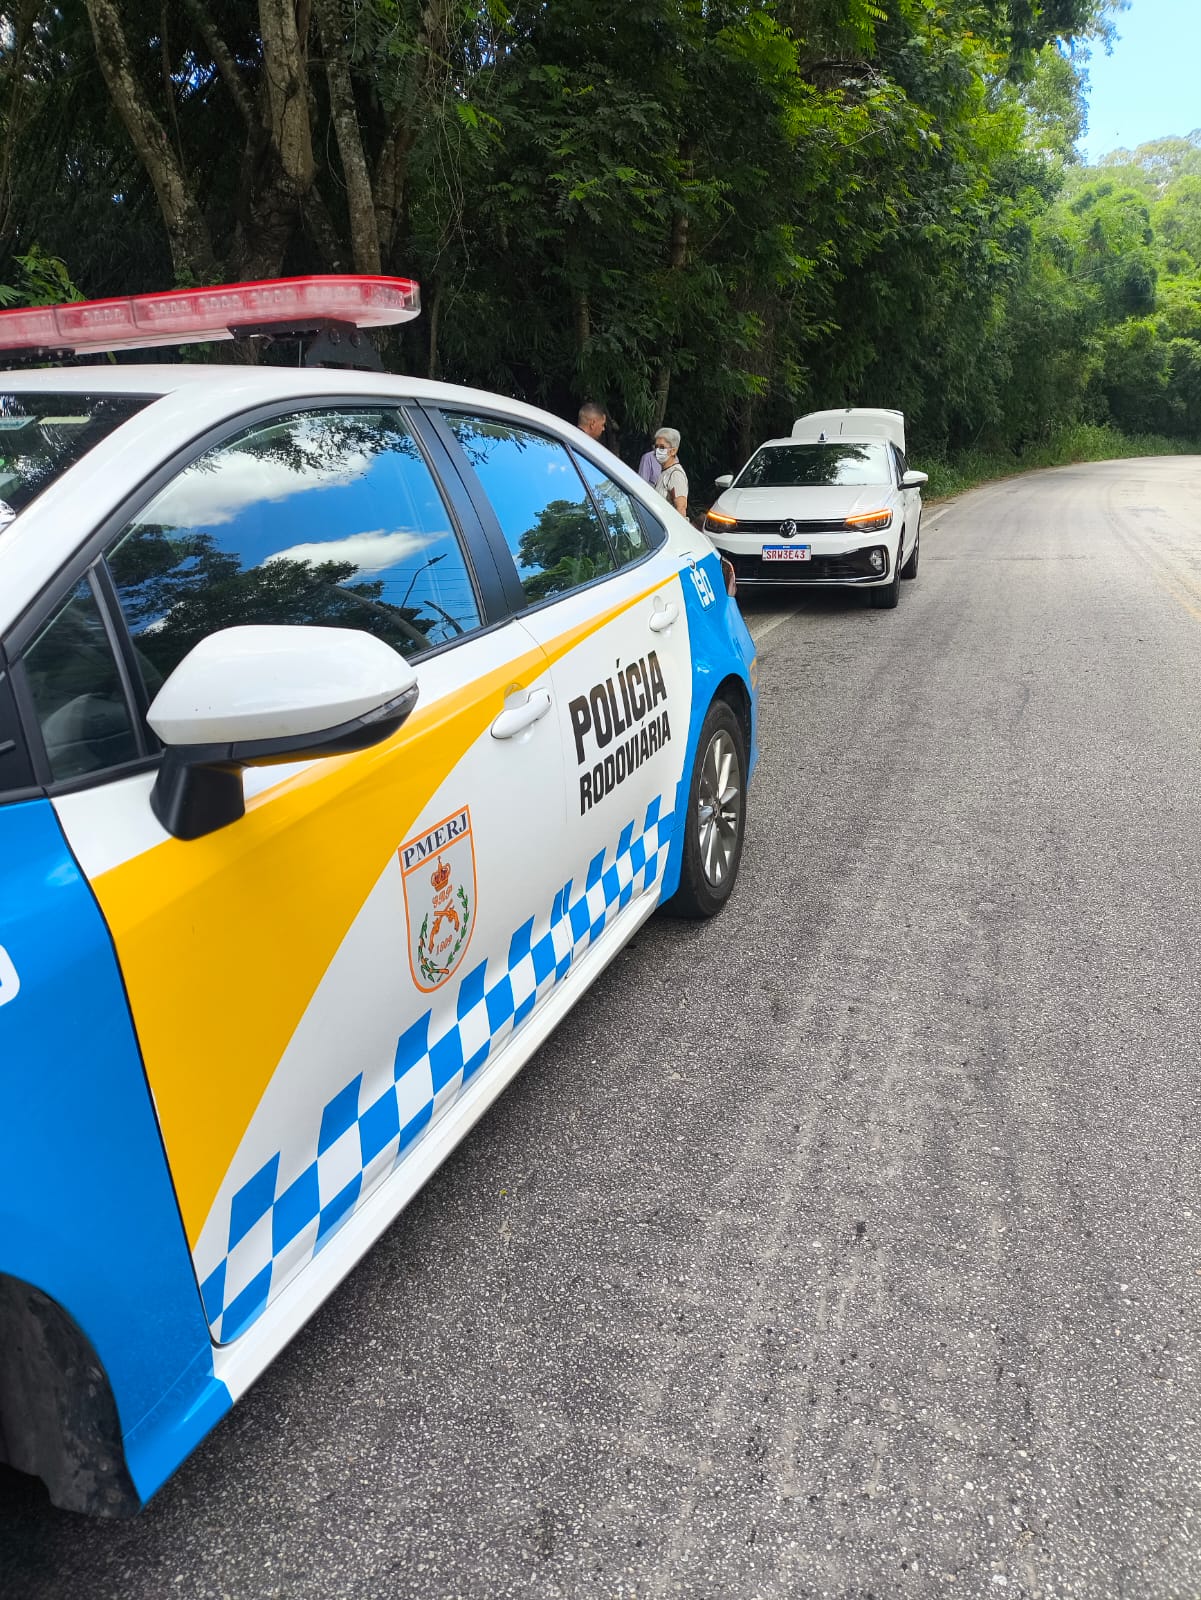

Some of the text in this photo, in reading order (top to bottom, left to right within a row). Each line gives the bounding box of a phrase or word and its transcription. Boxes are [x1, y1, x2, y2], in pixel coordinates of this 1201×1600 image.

[766, 550, 806, 560] SRW3E43
[690, 567, 715, 608] 190
[568, 650, 668, 765] POLÍCIA
[580, 710, 671, 816] RODOVIÁRIA
[402, 812, 467, 869] PMERJ
